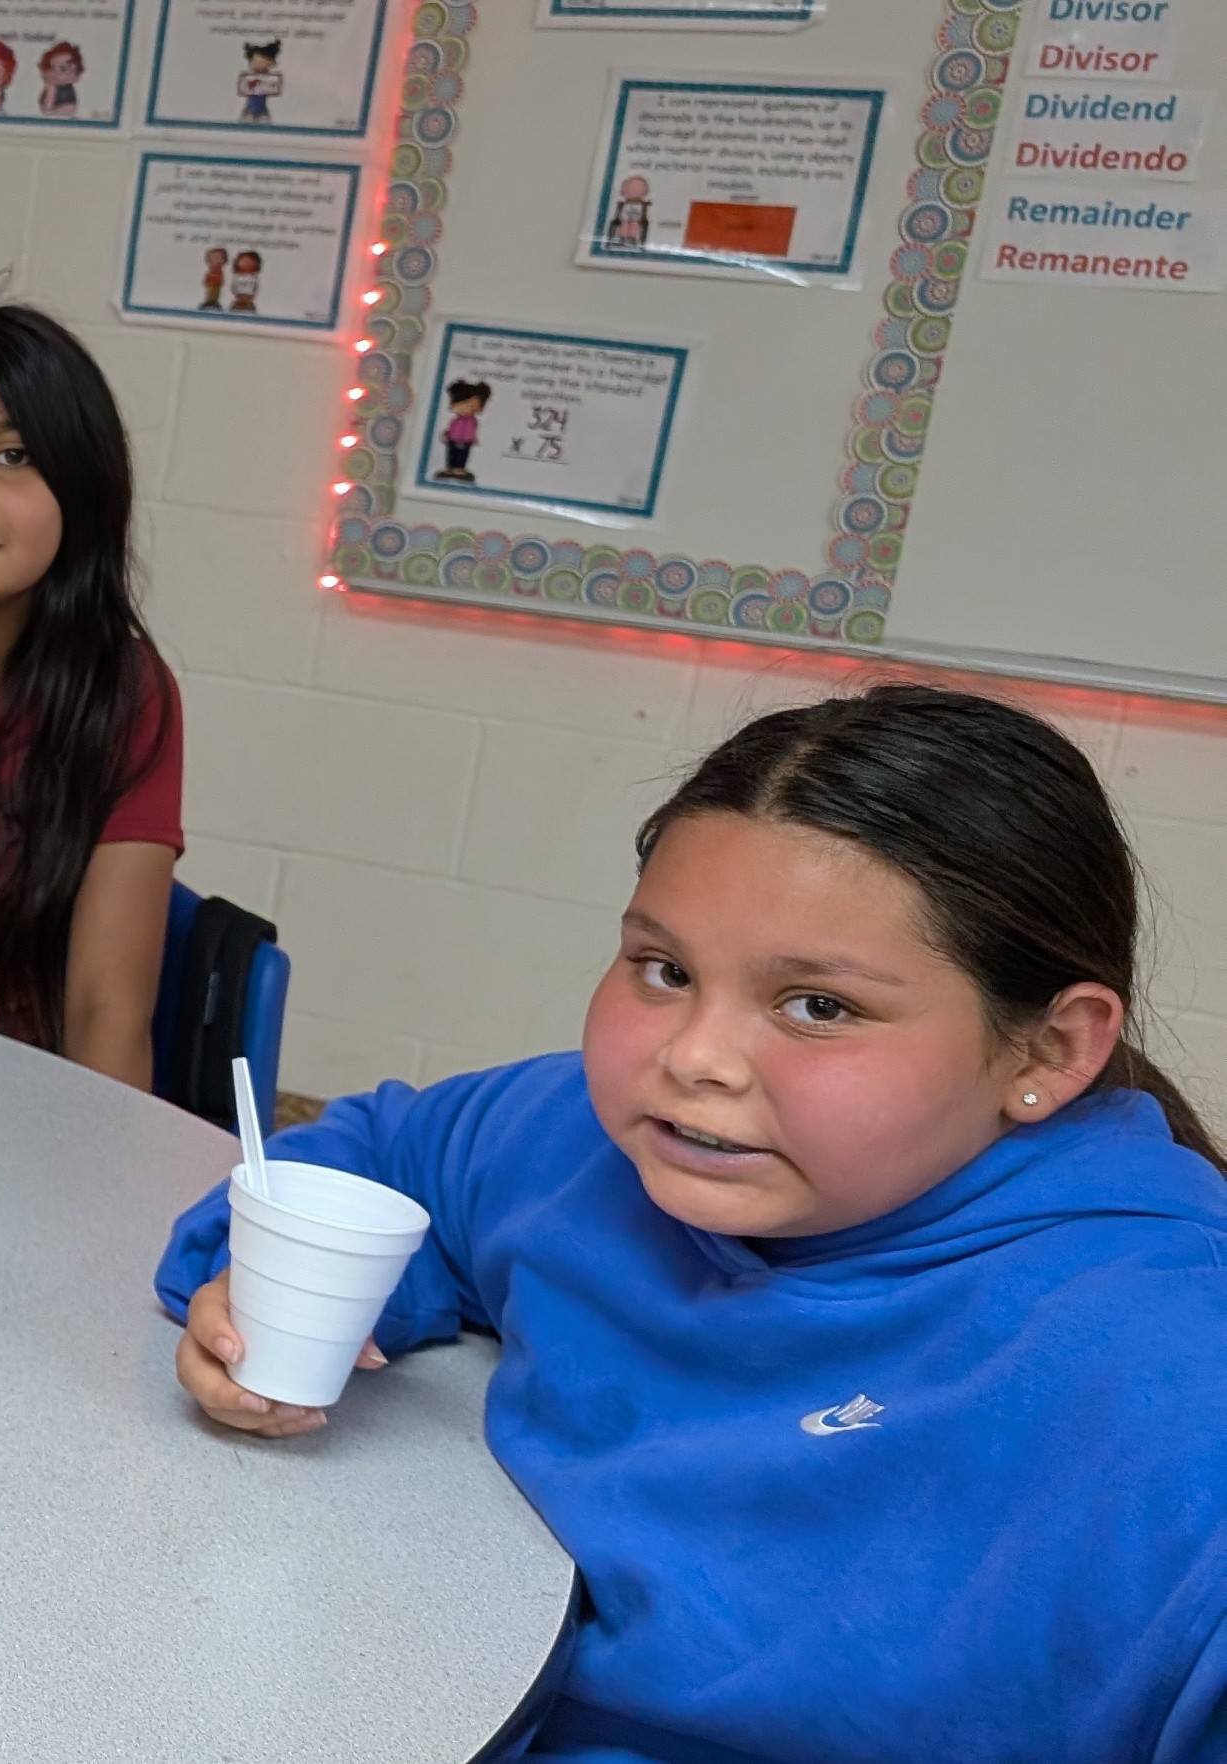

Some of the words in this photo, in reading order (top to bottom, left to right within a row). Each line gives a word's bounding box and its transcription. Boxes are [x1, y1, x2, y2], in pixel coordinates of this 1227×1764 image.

[1048, 0, 1169, 23] Divisor
[1038, 44, 1159, 73] Divisor
[1024, 93, 1177, 123] Dividend
[1015, 141, 1188, 173] Dividendo
[1007, 195, 1192, 231] Remainder
[996, 243, 1189, 281] Remanente
[527, 405, 569, 434] 324
[535, 432, 562, 460] 75
